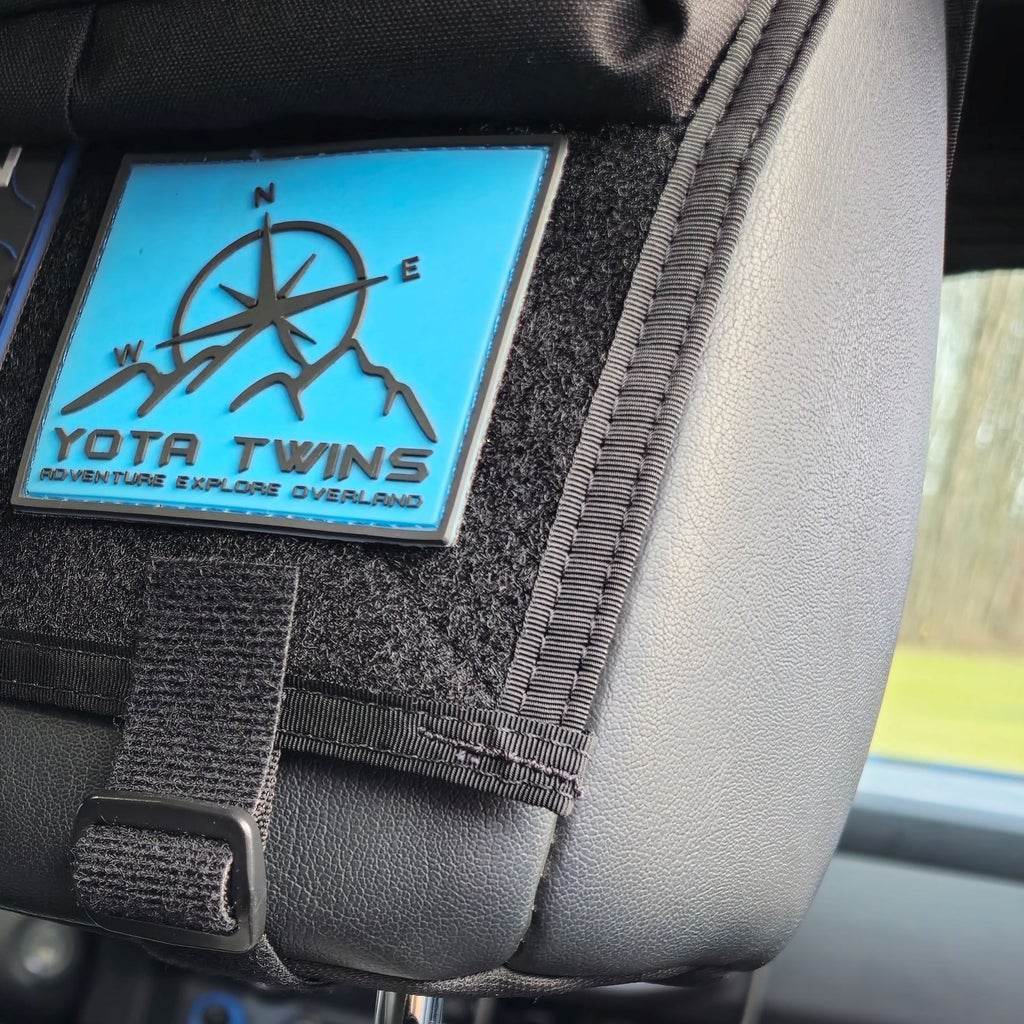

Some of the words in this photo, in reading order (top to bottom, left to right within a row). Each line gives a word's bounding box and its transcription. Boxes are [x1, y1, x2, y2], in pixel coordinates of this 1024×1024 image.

[253, 182, 275, 208] N
[401, 256, 421, 281] E
[113, 340, 144, 366] W
[53, 426, 202, 467] YOTA
[233, 435, 435, 484] TWINS
[39, 467, 165, 488] ADVENTURE
[176, 475, 281, 498] EXPLORE
[292, 485, 424, 509] OVERLAND
